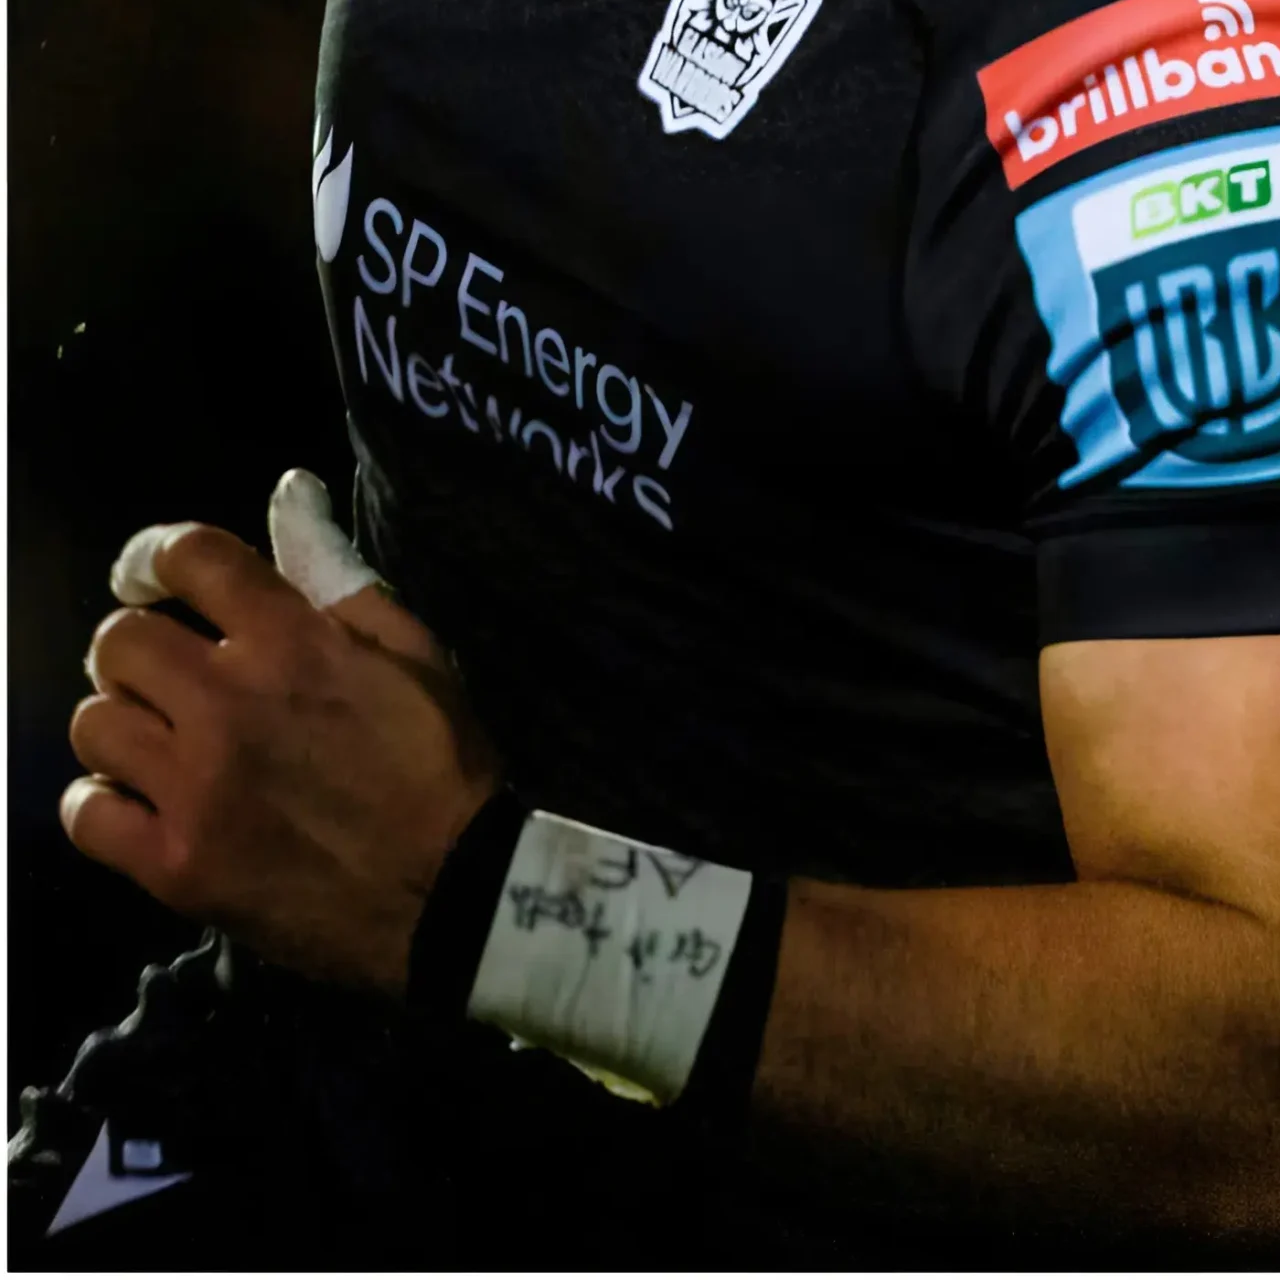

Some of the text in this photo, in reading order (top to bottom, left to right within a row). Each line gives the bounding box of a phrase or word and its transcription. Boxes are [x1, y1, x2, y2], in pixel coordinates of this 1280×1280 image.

[1130, 160, 1271, 240] BKT
[357, 198, 693, 470] SP Energy
